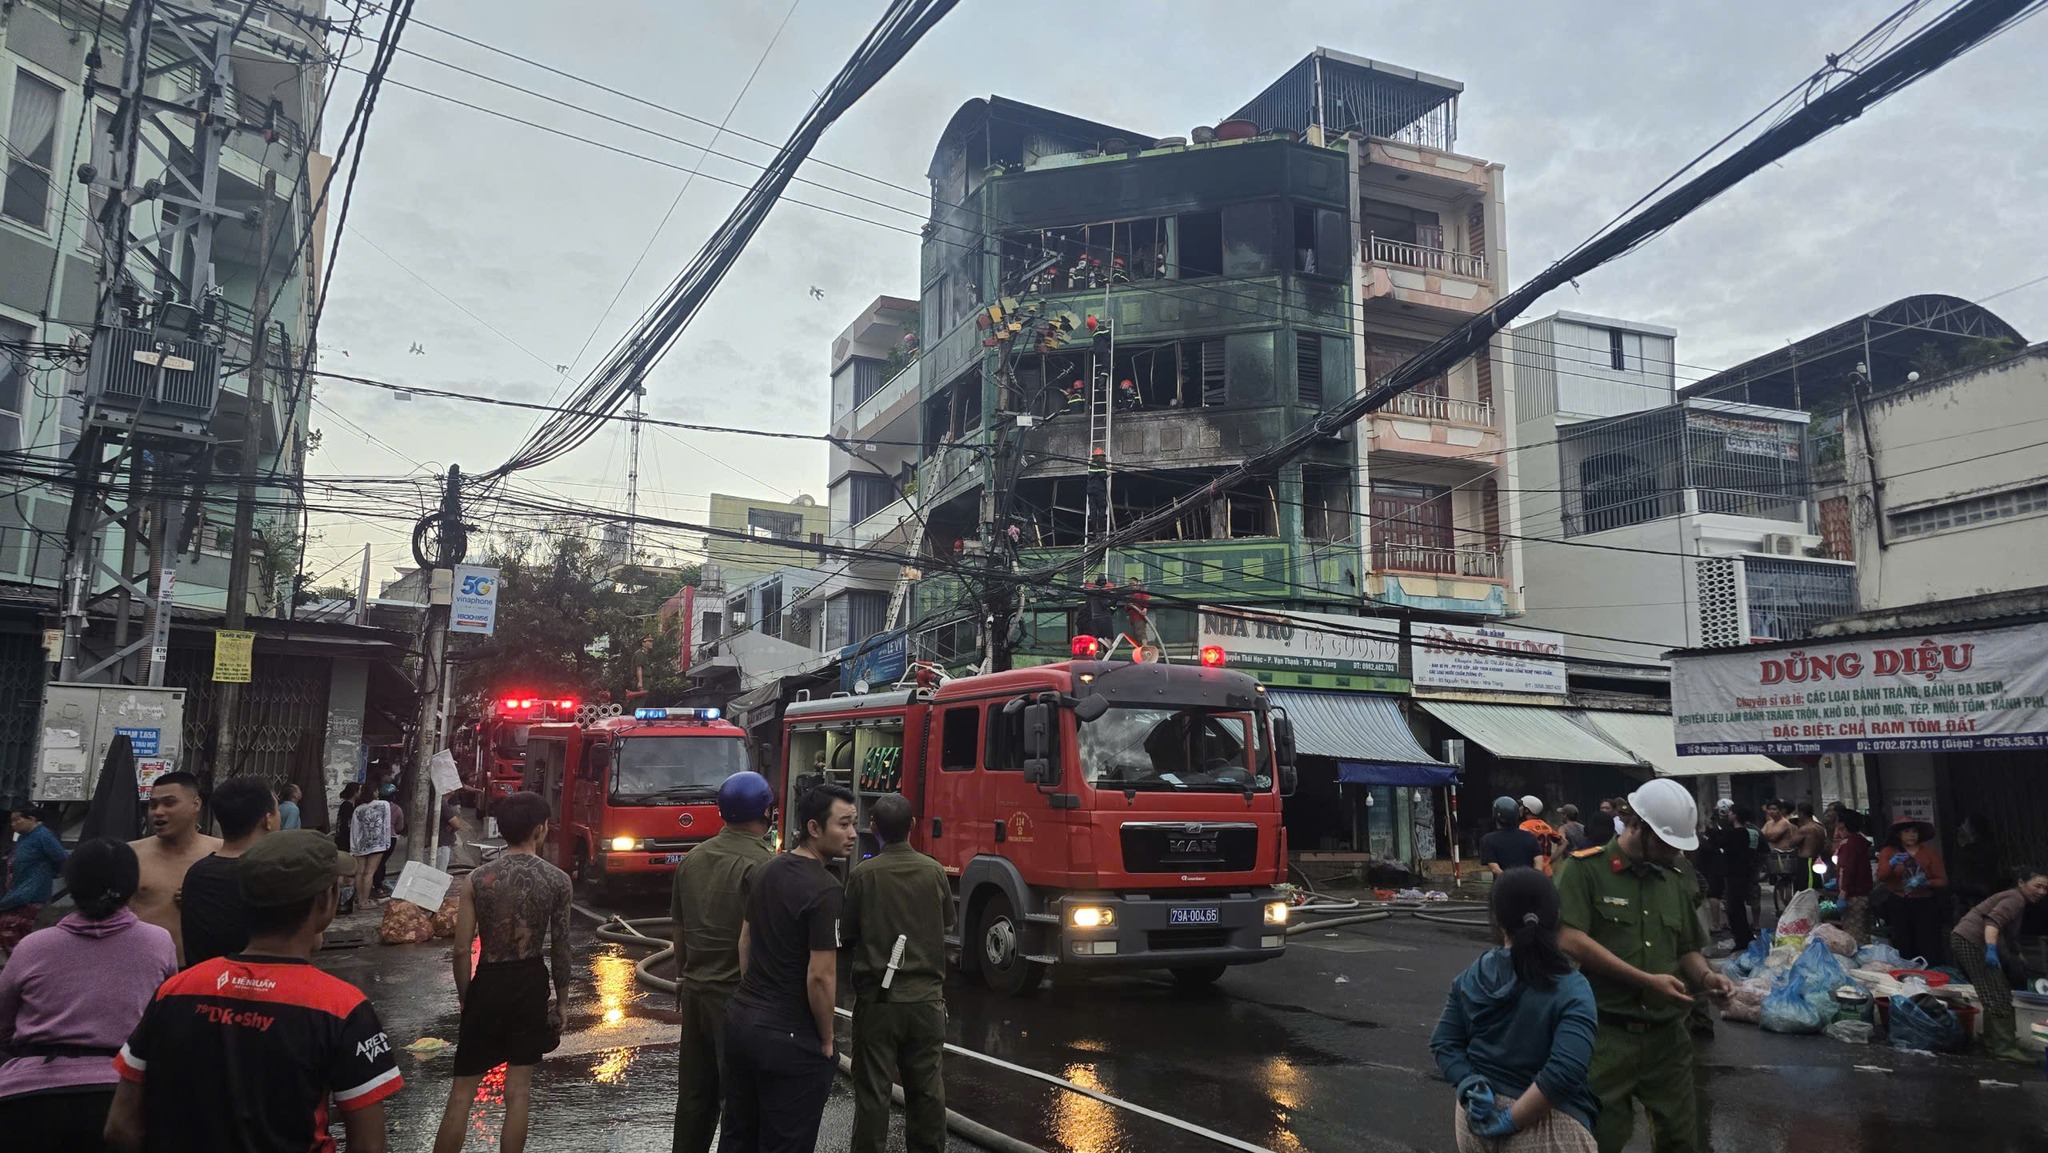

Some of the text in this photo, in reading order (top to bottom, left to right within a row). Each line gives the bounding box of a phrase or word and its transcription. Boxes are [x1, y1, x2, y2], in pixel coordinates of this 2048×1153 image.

[456, 596, 493, 606] vinaphone
[1241, 654, 1252, 662] Thái
[1254, 655, 1263, 664] Học
[1274, 656, 1283, 665] Vạn
[1285, 657, 1299, 666] Thạnh
[1323, 661, 1337, 669] Trang
[1760, 639, 1975, 685] DŨNG DIỆU
[1736, 696, 1767, 708] Chuyên
[1779, 694, 1791, 705] và
[1807, 690, 1826, 704] CÁC
[1829, 690, 1850, 705] LOẠI
[1853, 686, 1880, 701] BÁNH
[1924, 683, 1954, 698] BÁNH
[1958, 683, 1973, 696] ĐA
[1678, 712, 1706, 725] NGUYÊN
[1707, 711, 1724, 725] LIỆU
[1726, 711, 1741, 722] LÀM
[1743, 709, 1764, 722] BÁNH
[1766, 708, 1794, 721] TRÁNG
[1823, 706, 1843, 718] KHÔ
[1861, 704, 1880, 717] KHÔ
[1933, 699, 1960, 714] MUỐI
[1991, 697, 2022, 711] HÀNH
[1773, 715, 1976, 739] ĐẶC BIỆT: CHẢ RAM TÔM ĐẤT
[1701, 743, 1729, 755] Nguyễn
[1730, 744, 1747, 753] Thái
[1767, 744, 1775, 752] P.
[1776, 743, 1792, 754] Vạn
[1794, 743, 1820, 754] Thạnh
[1856, 741, 1871, 750] ĐT:
[1873, 739, 1939, 750] 0702.873.016
[1942, 739, 1973, 750] (Diệu)
[1170, 840, 1217, 852] MAN
[1172, 910, 1217, 922] 79A-004.65
[355, 1031, 388, 1057] AREN
[365, 1041, 392, 1064] VAL
